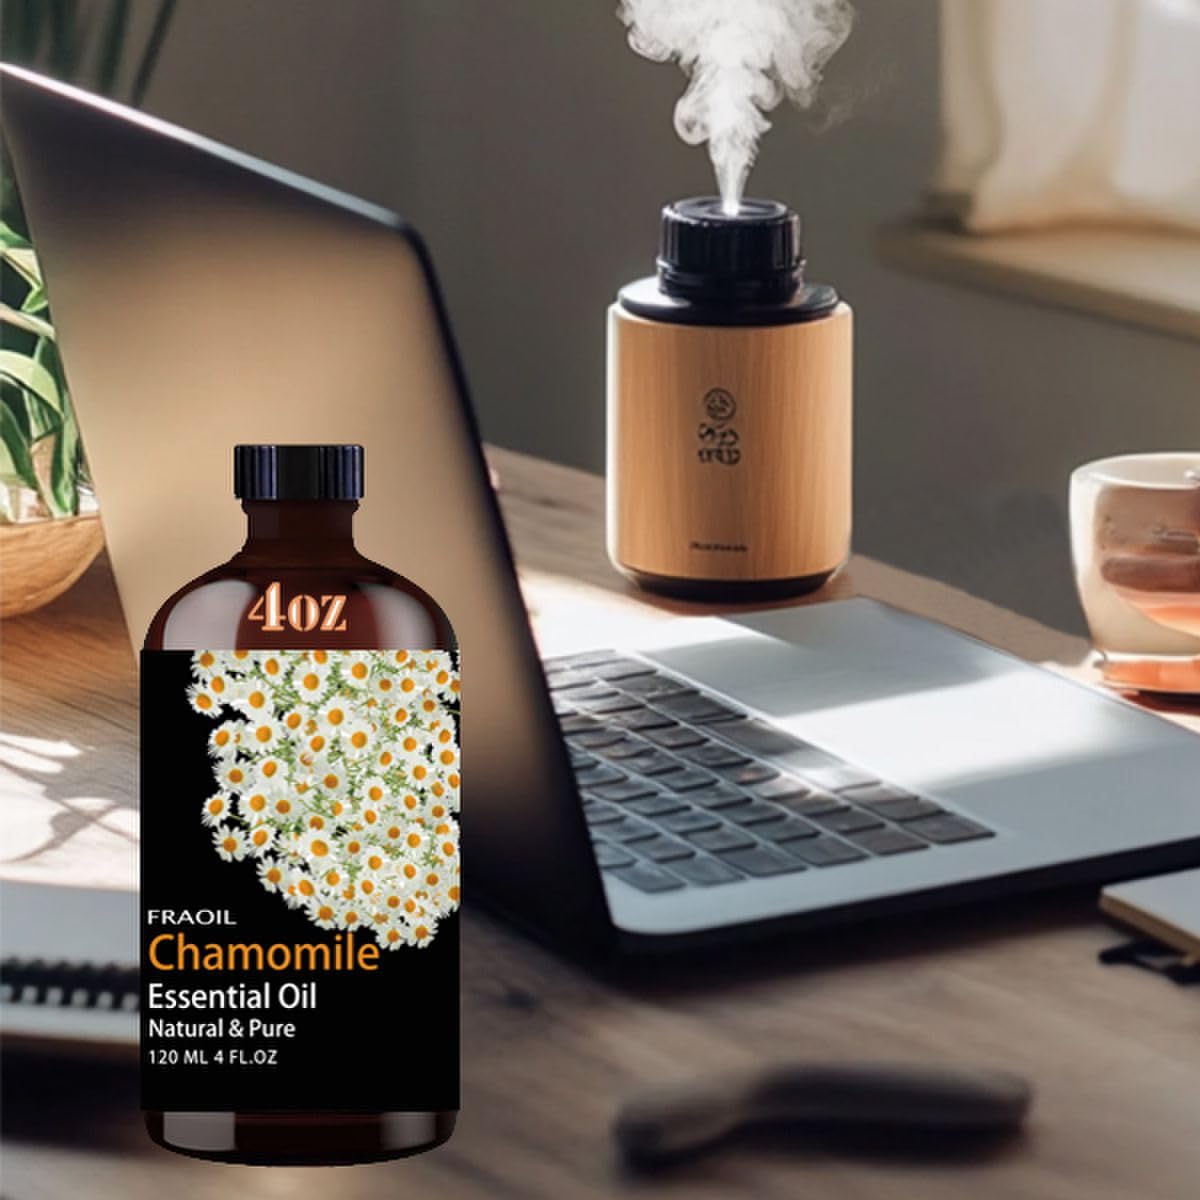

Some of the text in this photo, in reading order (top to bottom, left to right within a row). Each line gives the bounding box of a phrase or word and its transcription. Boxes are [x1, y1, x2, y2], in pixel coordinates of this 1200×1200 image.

[248, 581, 347, 632] 4oz
[148, 910, 236, 925] FRAOIL
[149, 932, 379, 970] Chamomile
[149, 982, 315, 1008] Essential Oil
[149, 1018, 295, 1037] Natural & Pure
[150, 1050, 277, 1064] 120 ML 4 FL.OZ
